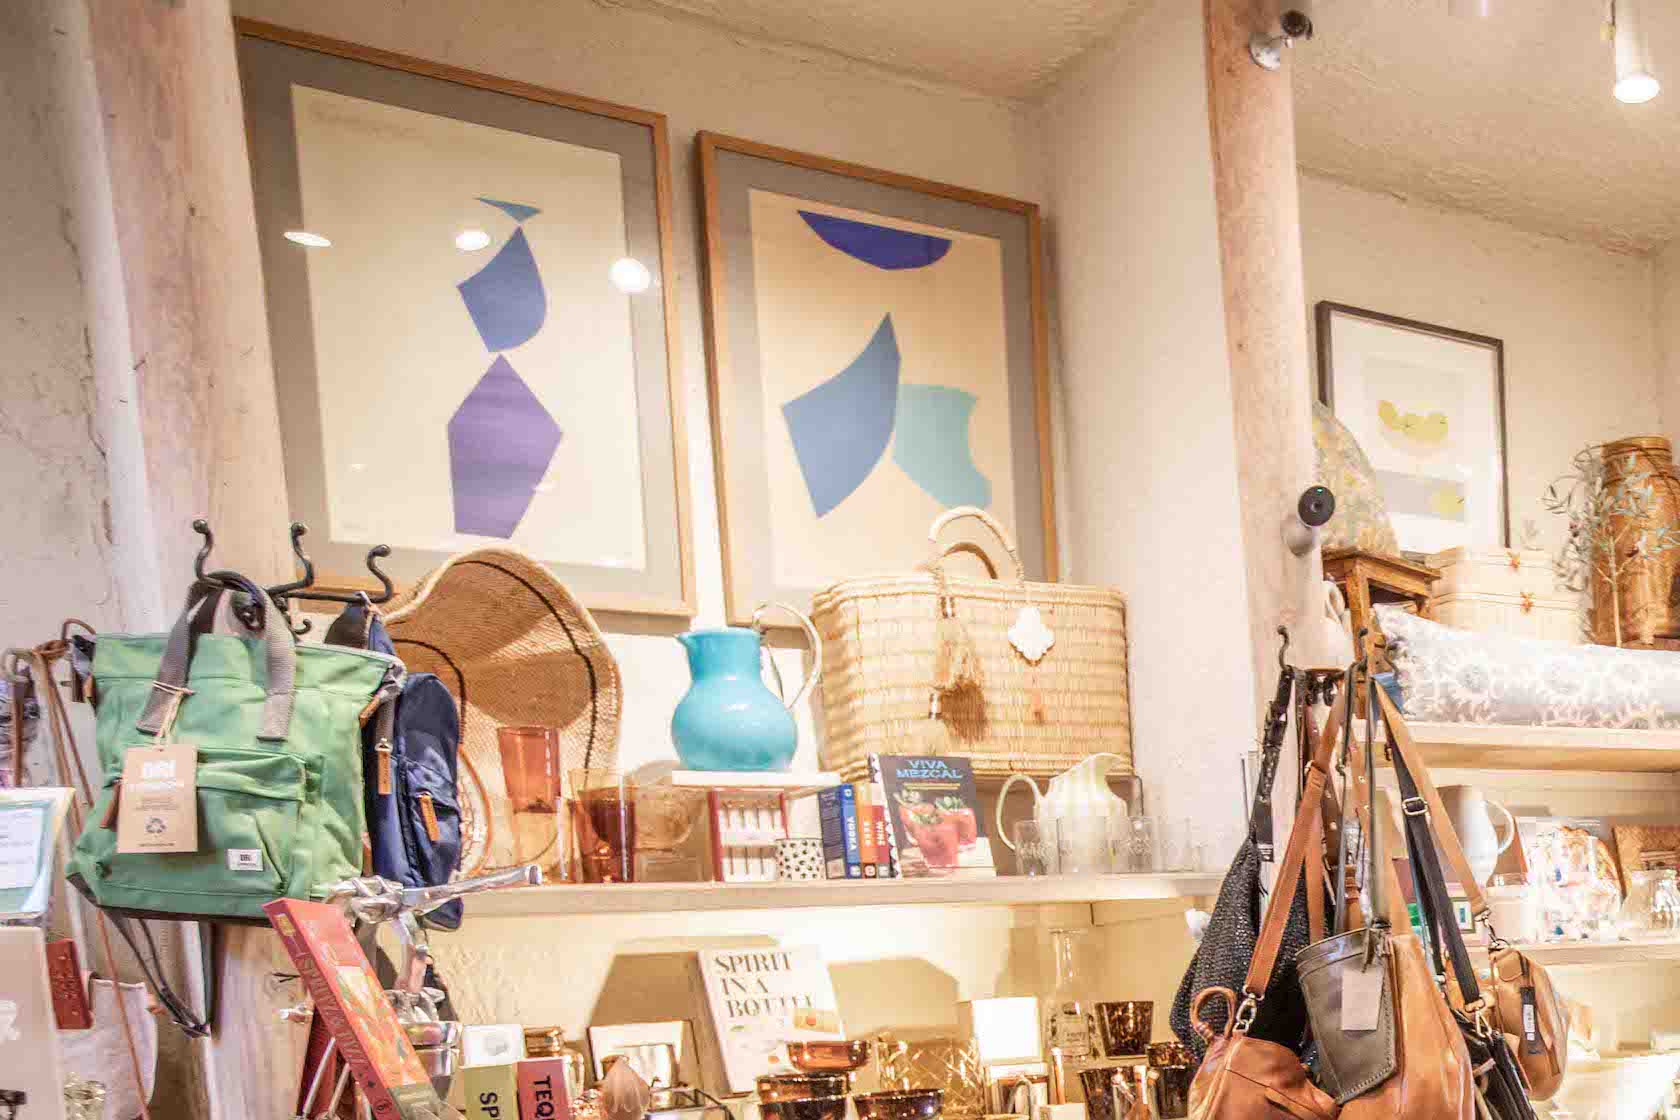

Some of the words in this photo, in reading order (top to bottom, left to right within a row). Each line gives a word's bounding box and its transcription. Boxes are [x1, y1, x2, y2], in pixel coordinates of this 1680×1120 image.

[896, 769, 963, 779] MEZCAL
[907, 759, 948, 769] VIVA
[847, 816, 857, 850] VODKA
[714, 952, 792, 974] SPIRIT
[721, 977, 747, 995] IN
[757, 978, 768, 993] A
[726, 995, 813, 1018] BOTTLE
